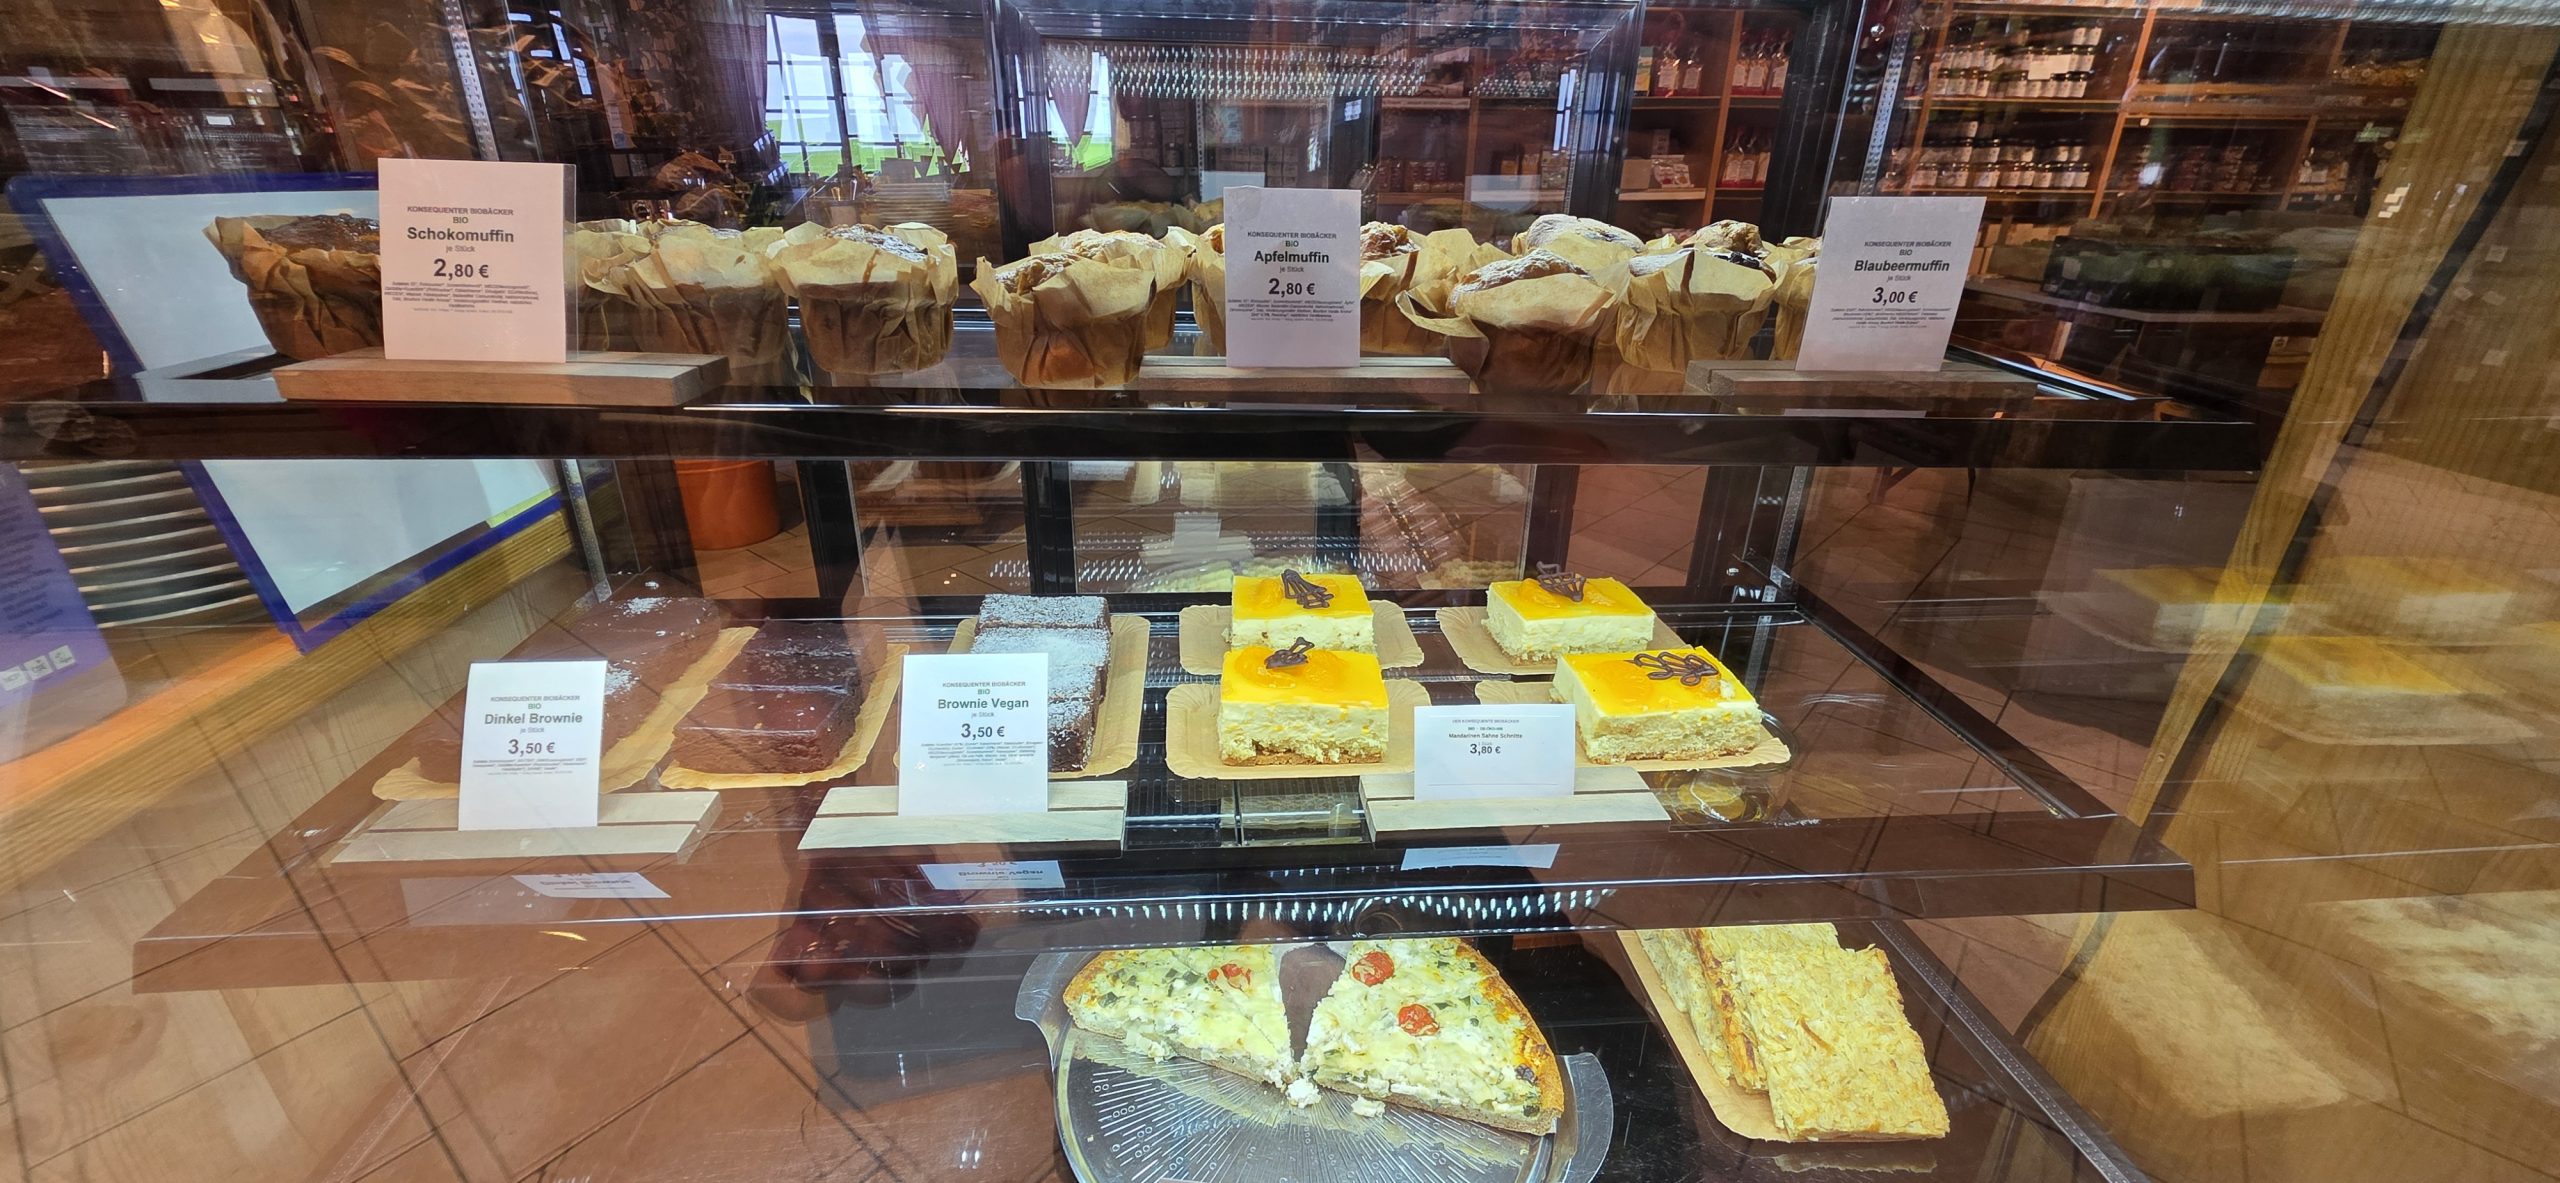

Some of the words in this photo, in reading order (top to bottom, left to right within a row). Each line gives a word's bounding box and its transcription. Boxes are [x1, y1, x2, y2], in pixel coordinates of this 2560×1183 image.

[407, 206, 468, 214] KONSEQUENTER
[470, 207, 514, 215] BIOBÄCKER
[407, 227, 514, 242] Schokomuffin
[446, 245, 452, 253] je
[1915, 239, 1951, 247] BIOBÄCKER
[1254, 251, 1329, 264] Apfelmuffin
[434, 258, 474, 280] 2,80
[479, 264, 489, 278] €
[1854, 260, 1950, 272] Blaubeermuffin
[1268, 278, 1302, 297] 2,80
[1306, 283, 1315, 295] €
[1872, 287, 1905, 305] 3,00
[1909, 291, 1918, 303] €
[938, 699, 988, 709] Brownie
[991, 698, 1029, 710] Vegan
[484, 713, 526, 725] Dinkel
[529, 712, 583, 724] Brownie
[961, 723, 993, 740] 3,50
[997, 726, 1005, 737] €
[508, 739, 542, 757] 3,50
[546, 742, 555, 753] €
[1470, 744, 1492, 756] 3,80
[1495, 746, 1501, 754] €
